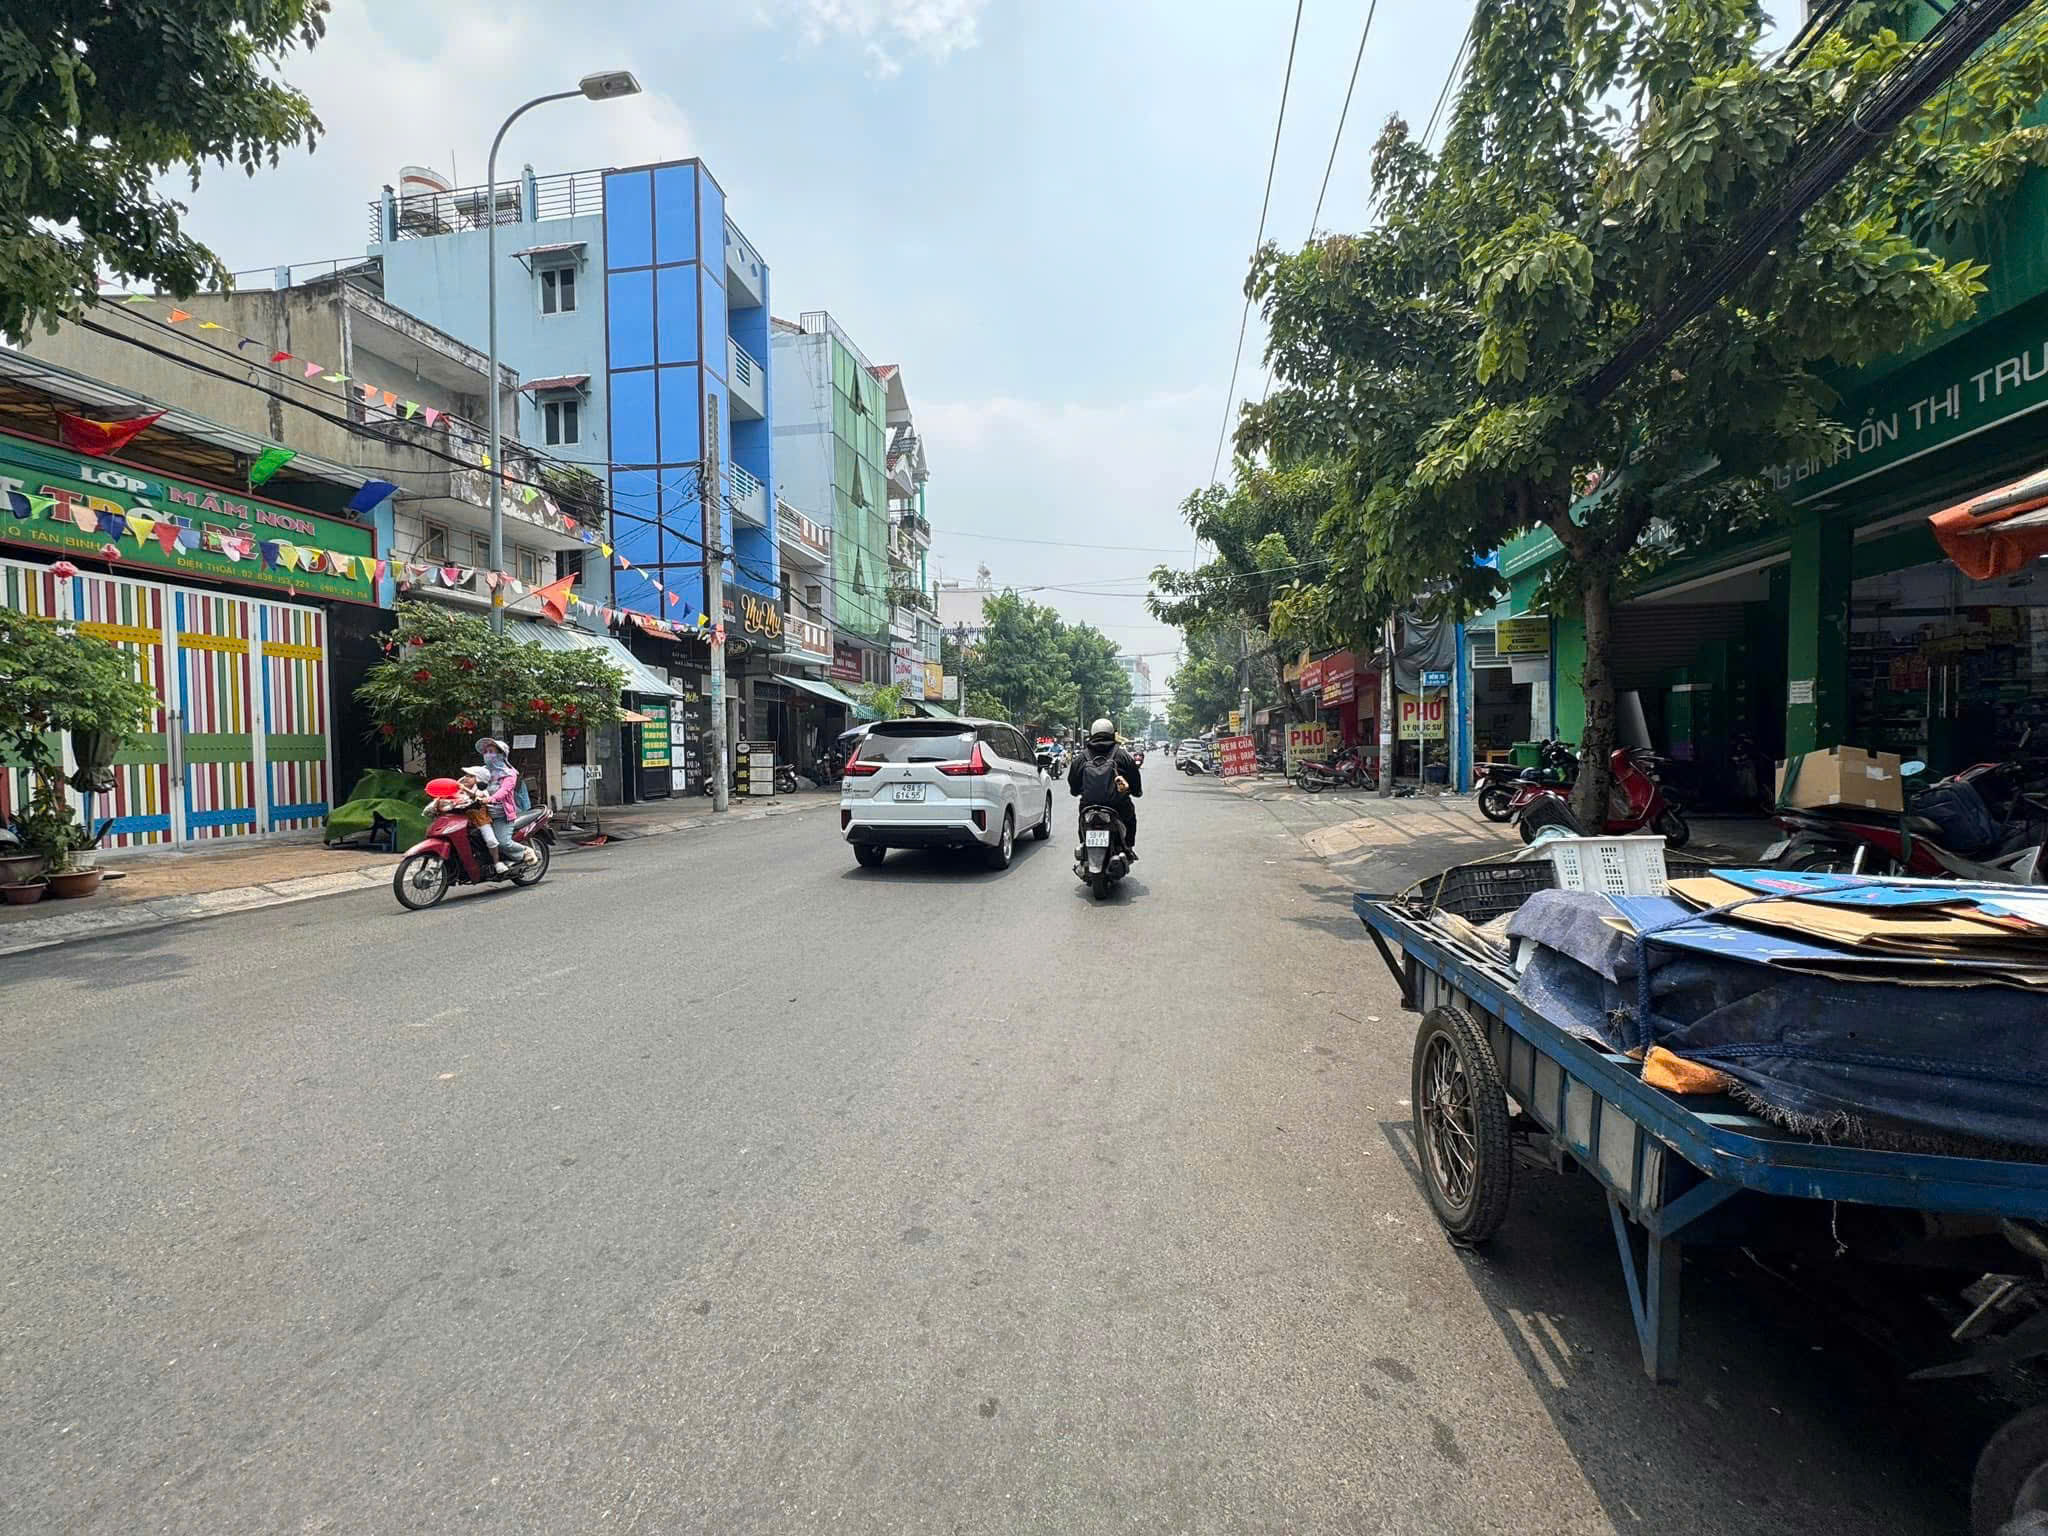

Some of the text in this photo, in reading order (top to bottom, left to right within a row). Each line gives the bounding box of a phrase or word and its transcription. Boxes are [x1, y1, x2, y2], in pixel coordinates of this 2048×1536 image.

[1857, 407, 1899, 454] ỔN
[1907, 383, 1961, 431] THỊ
[80, 464, 148, 493] LỚP
[255, 508, 316, 537] NON
[1403, 695, 1442, 721] PHỞ
[1290, 723, 1325, 747] PHỞ
